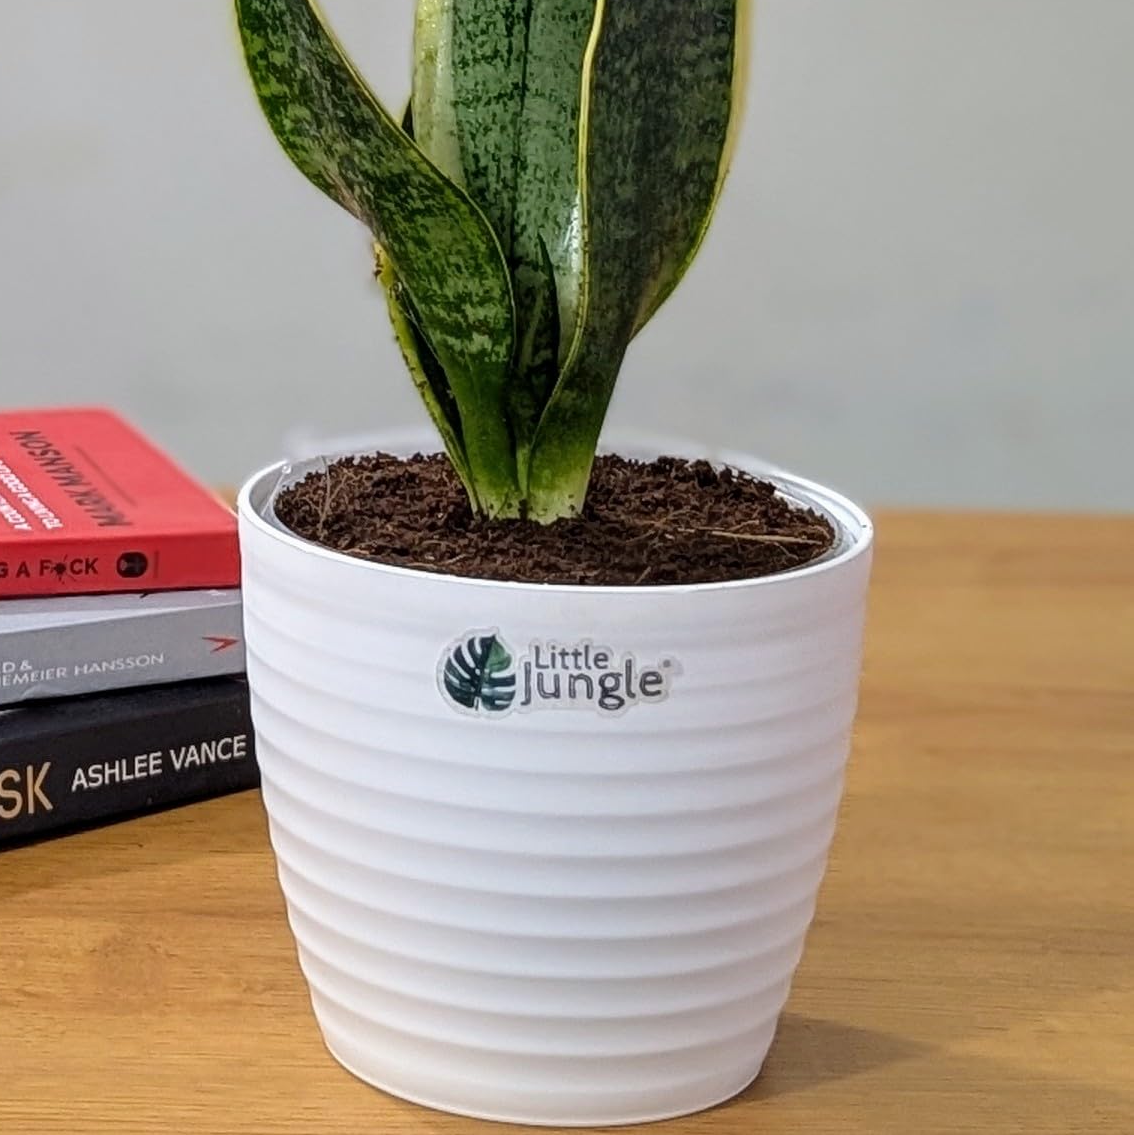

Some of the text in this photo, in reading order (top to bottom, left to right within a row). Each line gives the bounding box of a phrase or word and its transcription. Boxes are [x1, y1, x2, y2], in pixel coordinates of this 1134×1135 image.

[9, 430, 133, 527] MARK MANSON
[16, 562, 30, 578] A
[19, 659, 33, 672] &
[73, 653, 165, 677] HANSSON
[534, 644, 610, 671] Little
[520, 658, 664, 711] Jungle
[71, 733, 248, 792] ASHLEE VANCE
